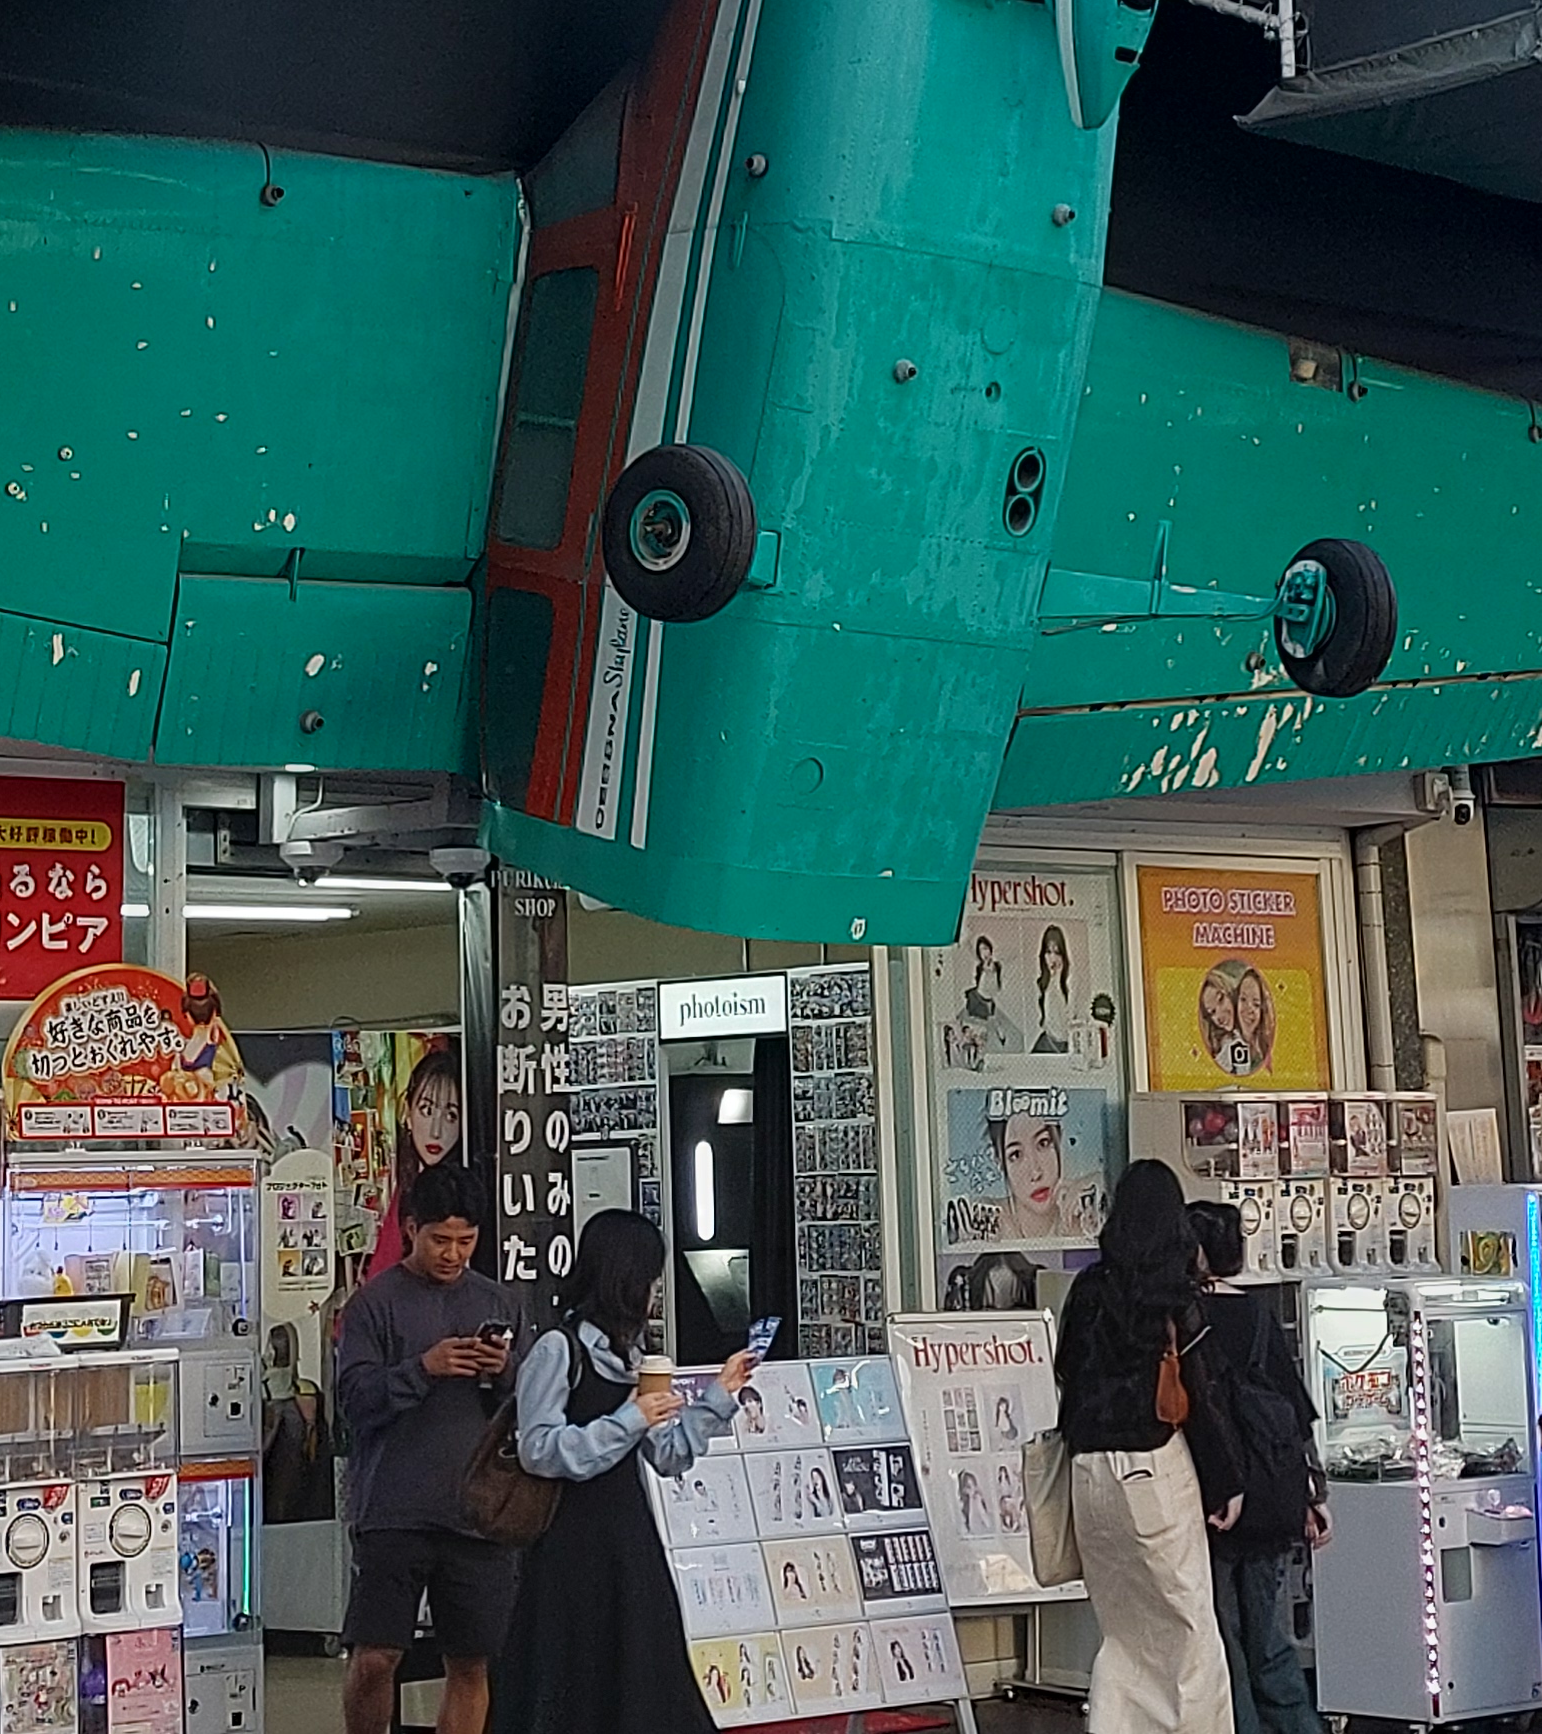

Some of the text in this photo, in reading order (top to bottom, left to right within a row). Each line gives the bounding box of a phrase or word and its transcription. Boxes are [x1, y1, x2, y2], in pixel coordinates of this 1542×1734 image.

[491, 870, 565, 890] PURIKU
[515, 898, 556, 917] SHOP
[1161, 886, 1296, 917] PHOTO STICKER
[1193, 921, 1277, 949] MACHINE
[46, 1003, 160, 1047] 好きな商品を
[680, 991, 766, 1027] photoism
[987, 1087, 1070, 1121] Bloomit
[540, 983, 574, 1307] 男性のみの
[911, 1334, 1045, 1375] Hypershot.
